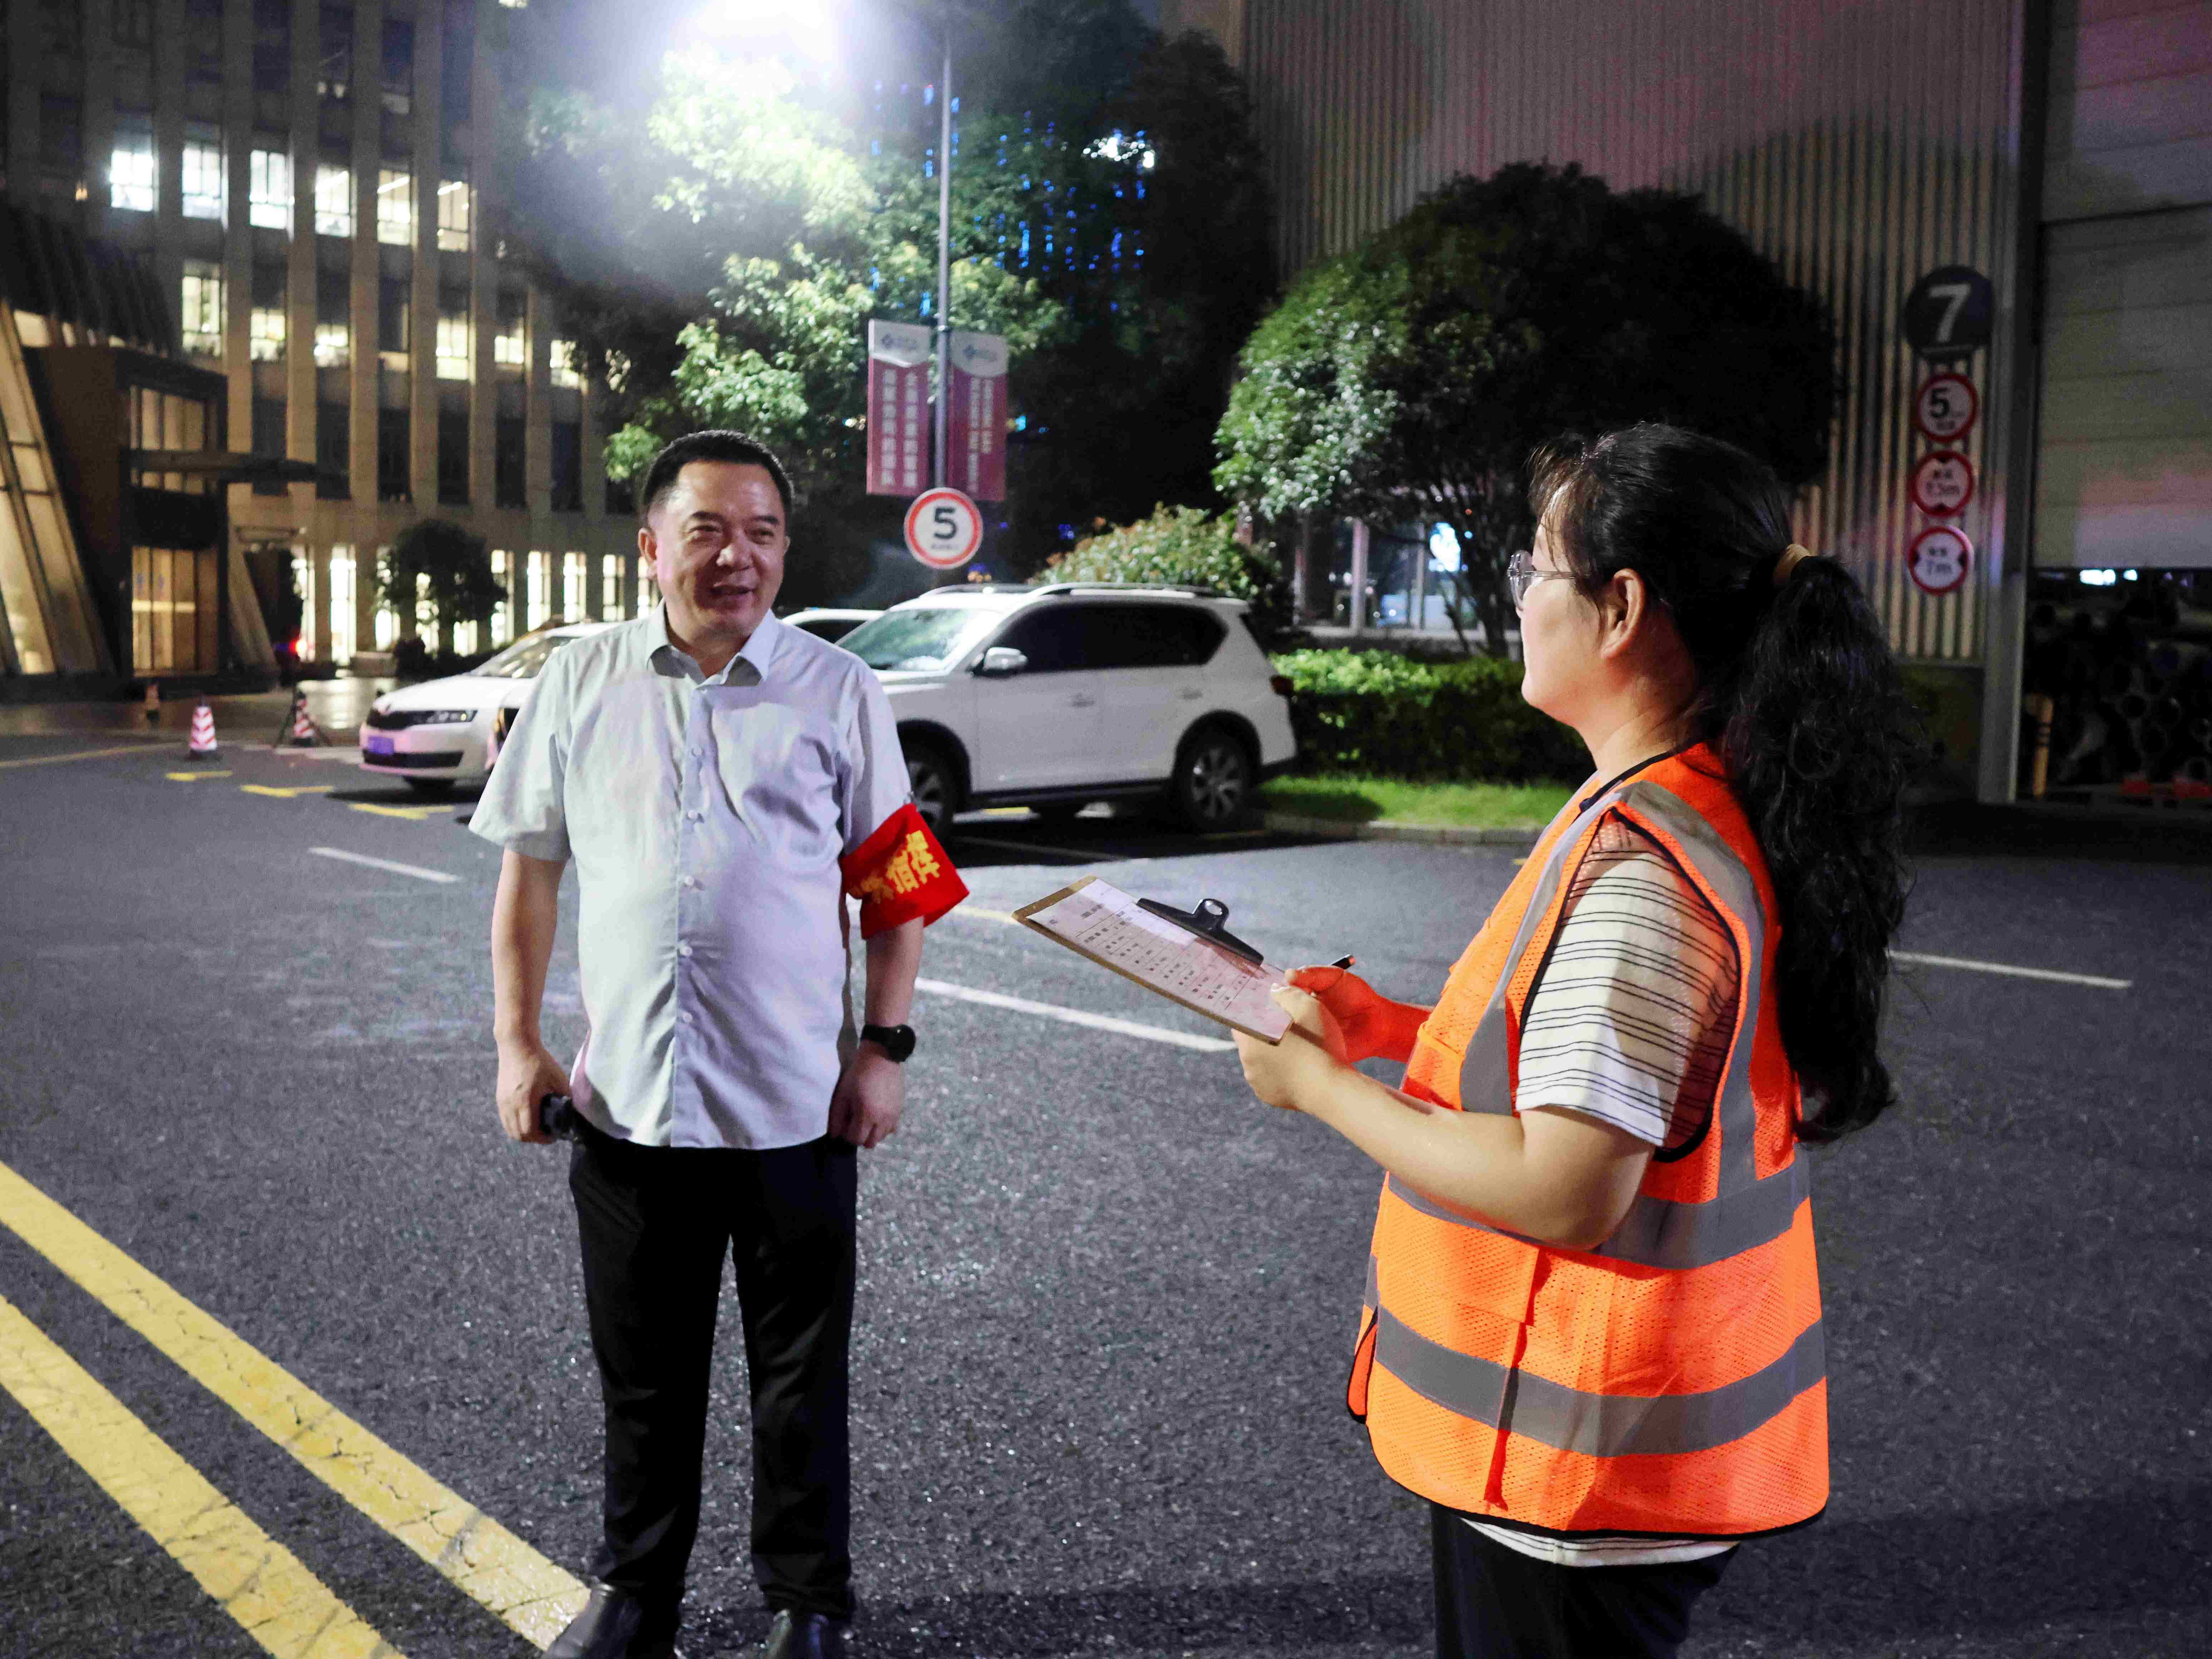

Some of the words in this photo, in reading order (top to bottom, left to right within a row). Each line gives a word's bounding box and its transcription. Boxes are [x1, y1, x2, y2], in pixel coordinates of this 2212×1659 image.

[1928, 283, 1971, 342] 7
[1930, 387, 1950, 418] 5
[934, 507, 957, 539] 5
